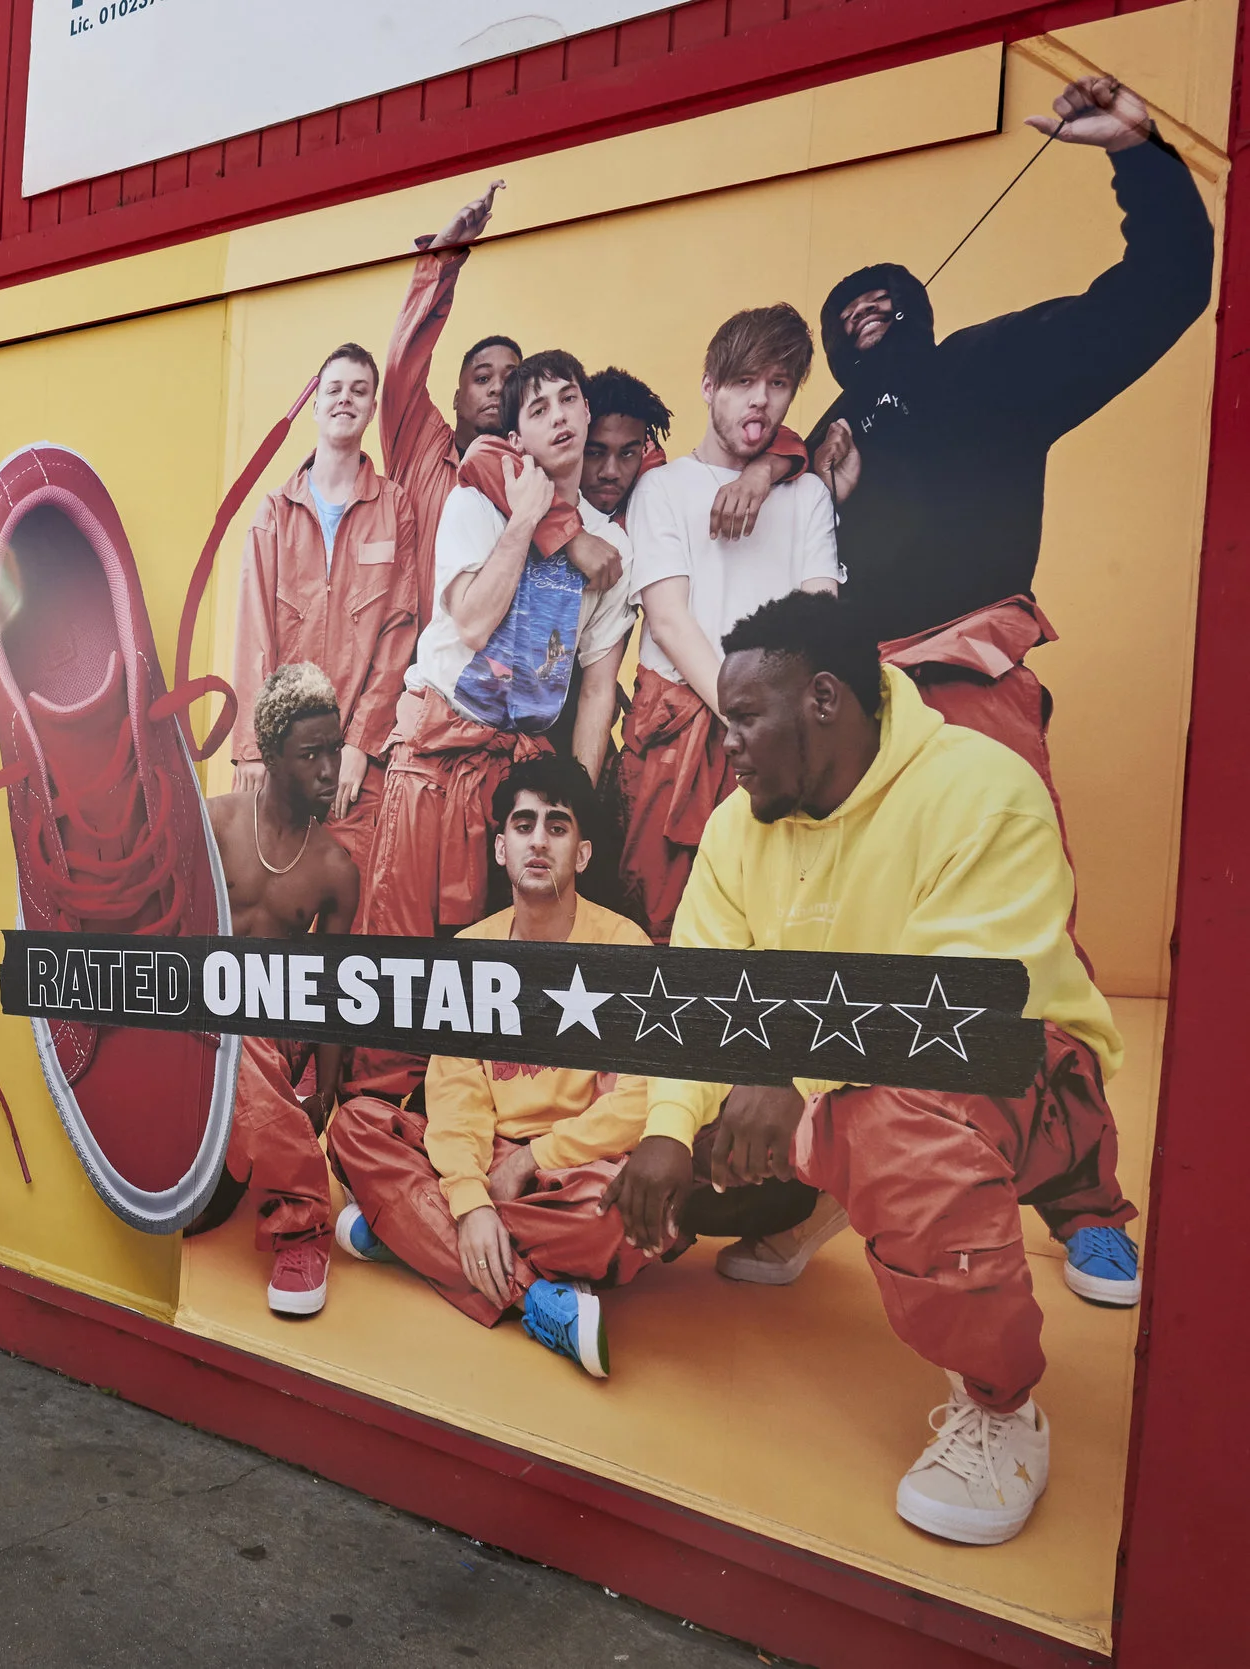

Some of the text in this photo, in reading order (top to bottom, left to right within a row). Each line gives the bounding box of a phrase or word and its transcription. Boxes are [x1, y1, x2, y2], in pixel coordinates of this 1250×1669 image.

[70, 16, 93, 36] Lic.
[27, 947, 522, 1036] RATED ONE STAR
